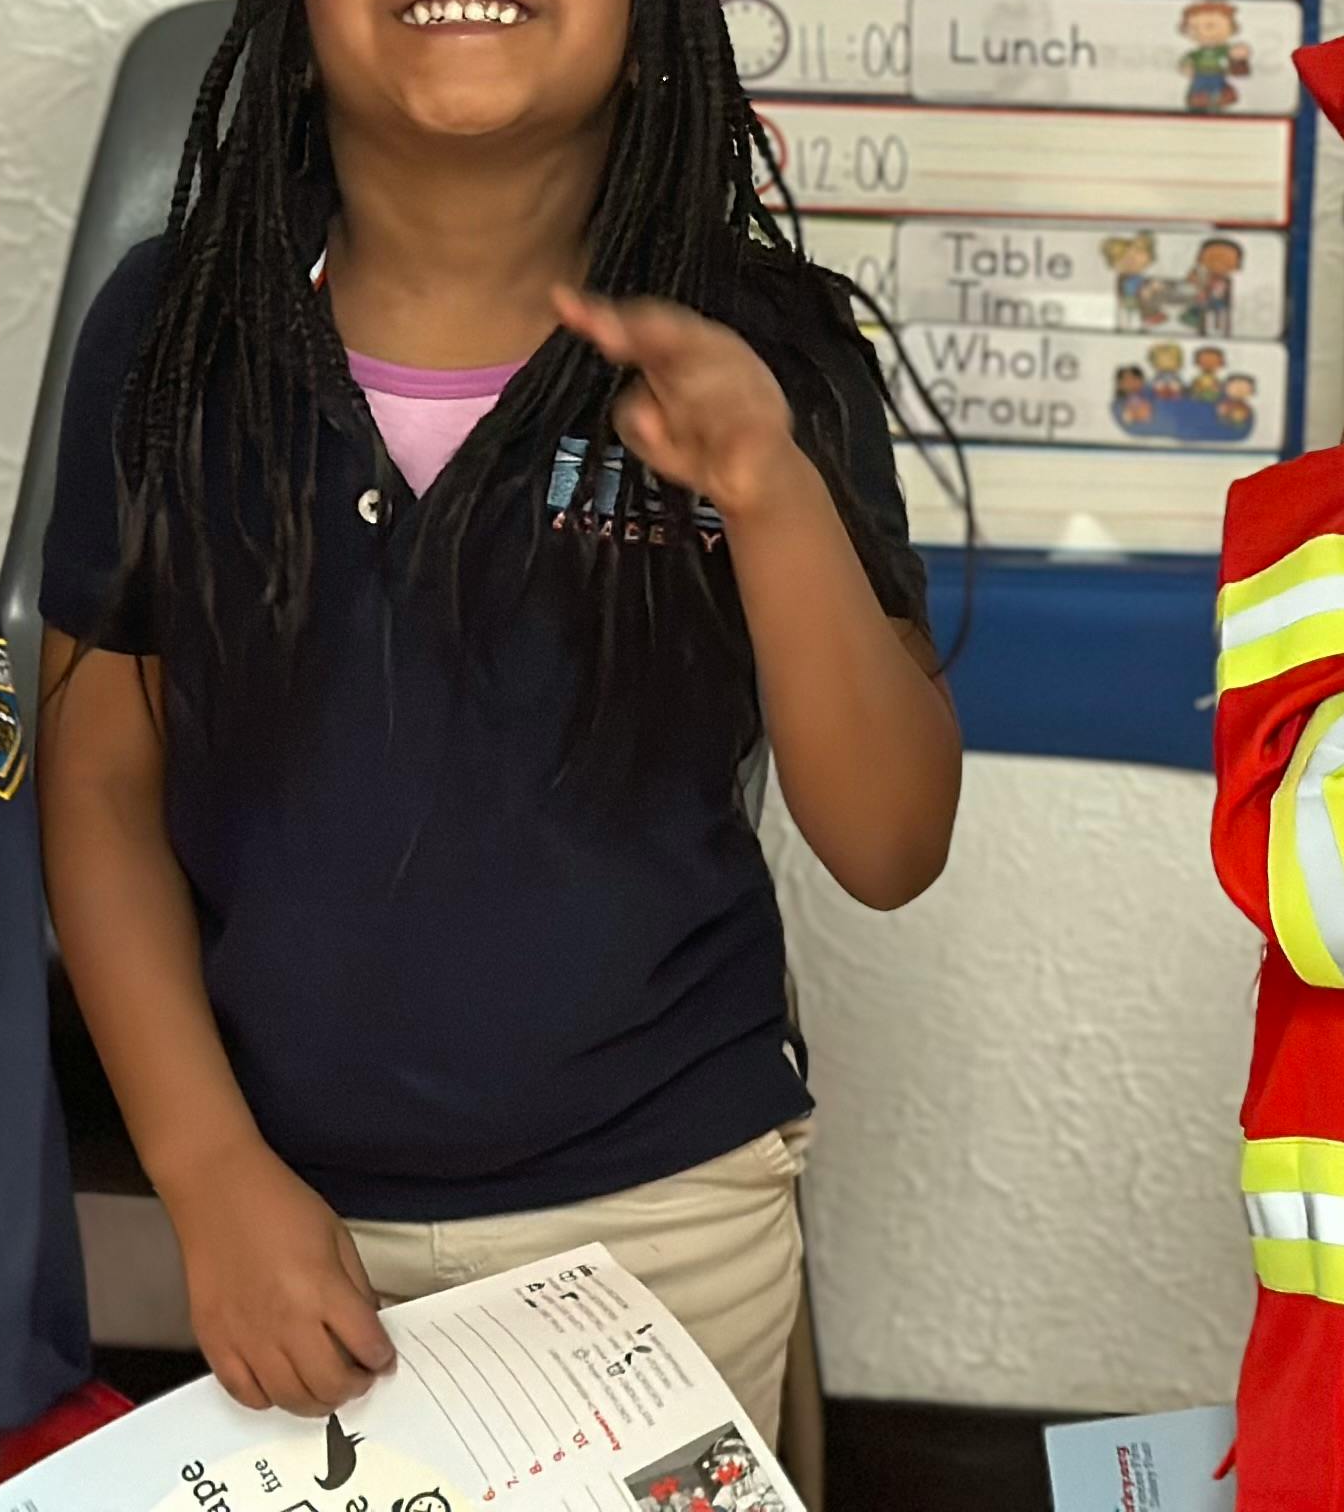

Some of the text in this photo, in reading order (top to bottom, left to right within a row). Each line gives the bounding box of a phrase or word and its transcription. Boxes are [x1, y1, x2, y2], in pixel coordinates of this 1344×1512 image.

[797, 20, 912, 83] 11:00
[948, 18, 1099, 70] Lunch
[795, 134, 910, 191] 12:00
[939, 232, 1076, 284] Table
[948, 279, 1068, 328] Time
[923, 328, 1082, 384] Whole
[925, 377, 1077, 438] Group
[254, 1457, 284, 1495] fire
